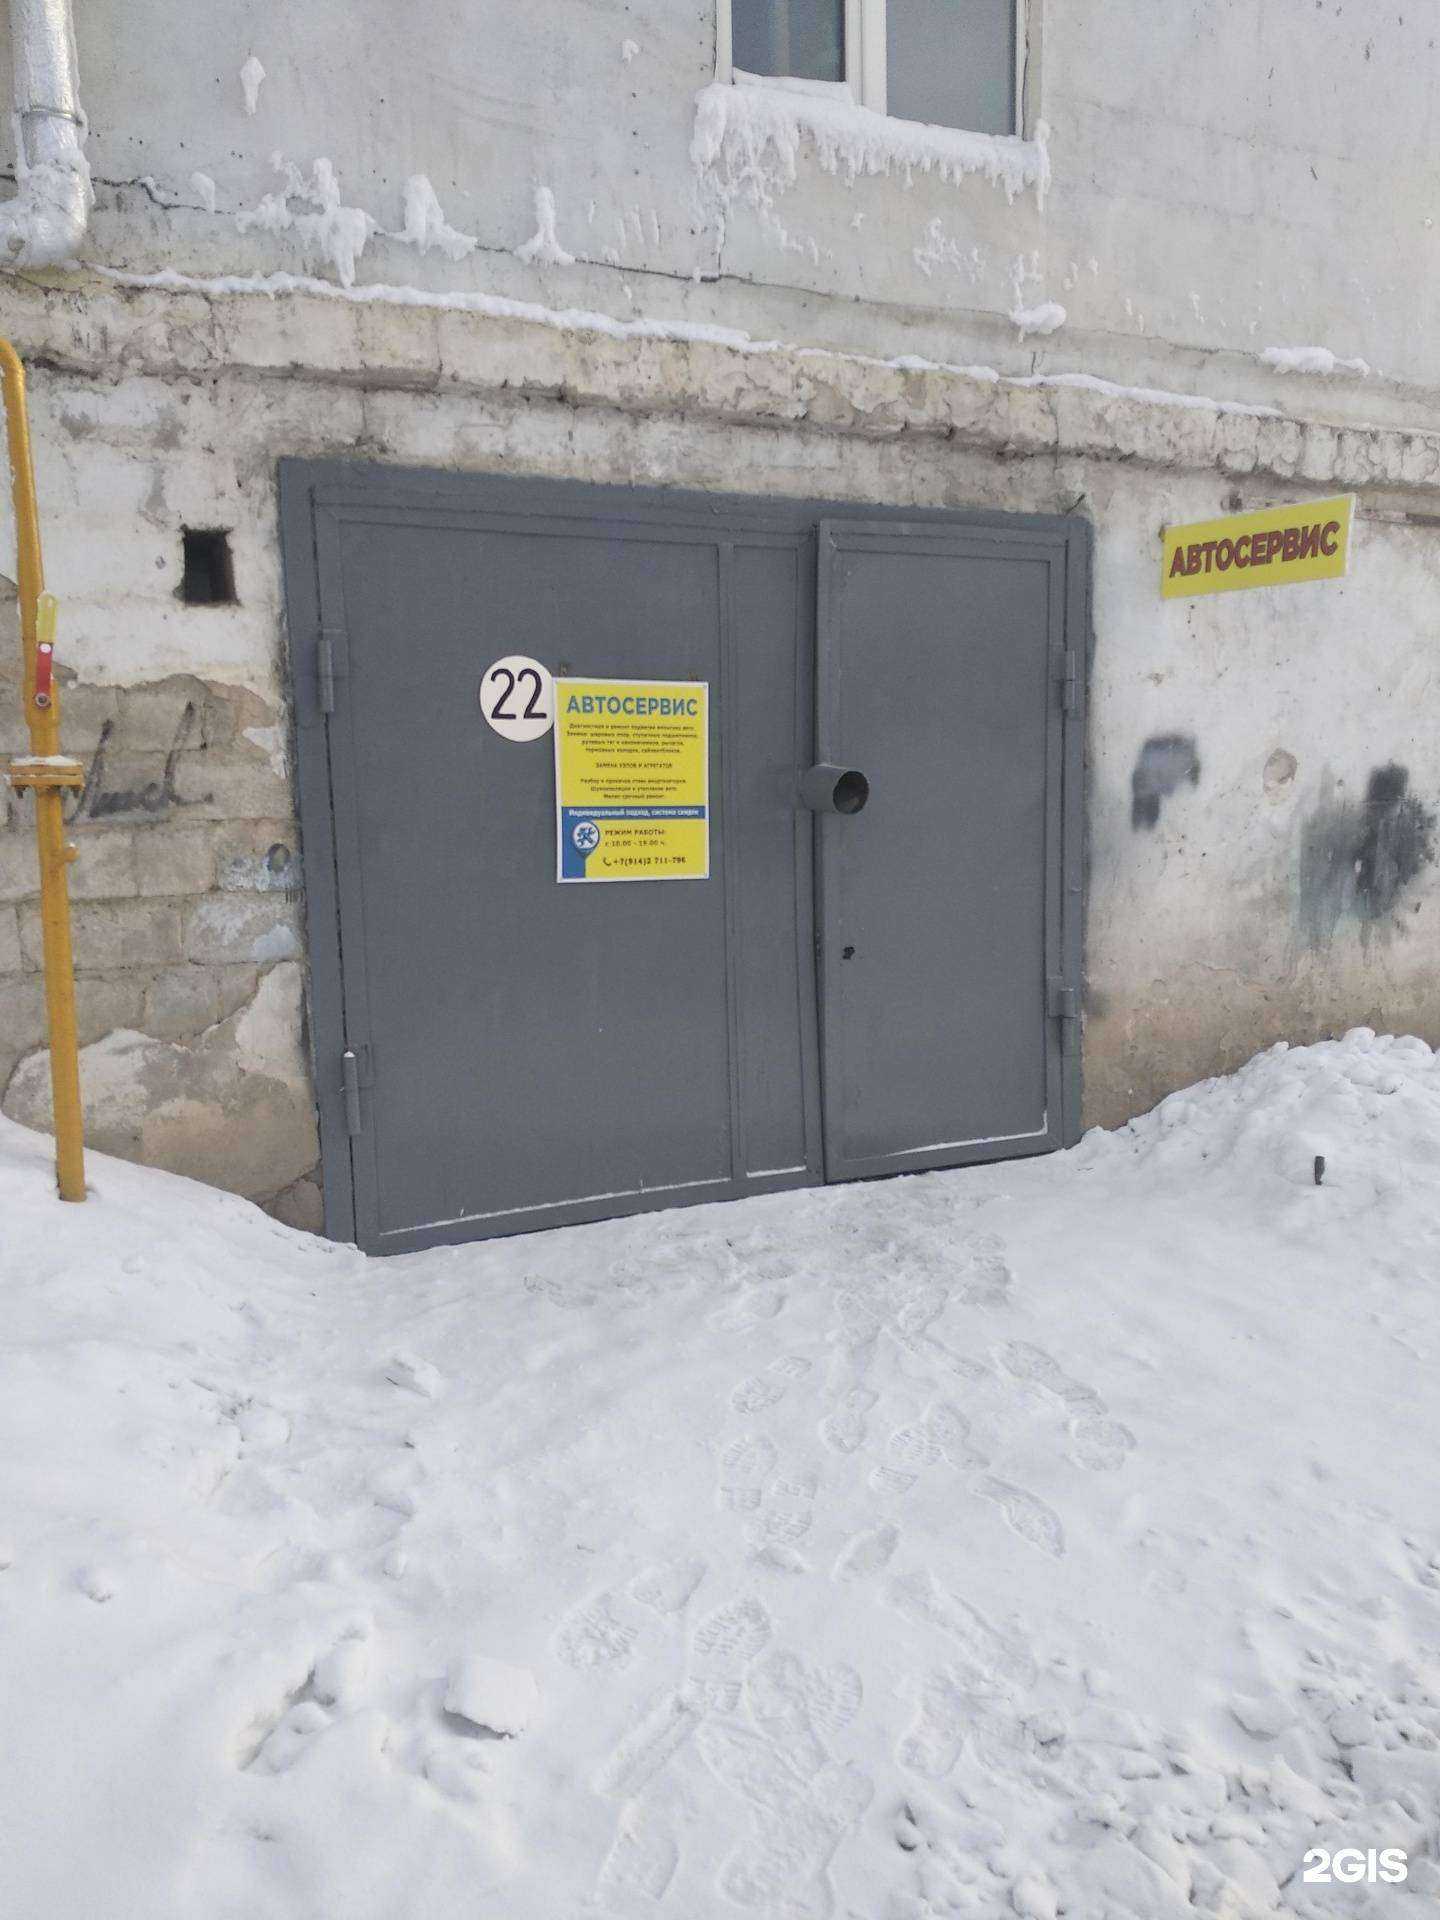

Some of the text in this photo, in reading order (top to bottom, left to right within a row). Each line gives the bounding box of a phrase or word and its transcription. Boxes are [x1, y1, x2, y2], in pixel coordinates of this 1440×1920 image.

[1169, 521, 1340, 578] АВТОСЕРВИС
[491, 668, 547, 719] 22
[566, 695, 698, 716] АВТОСЕРВИС
